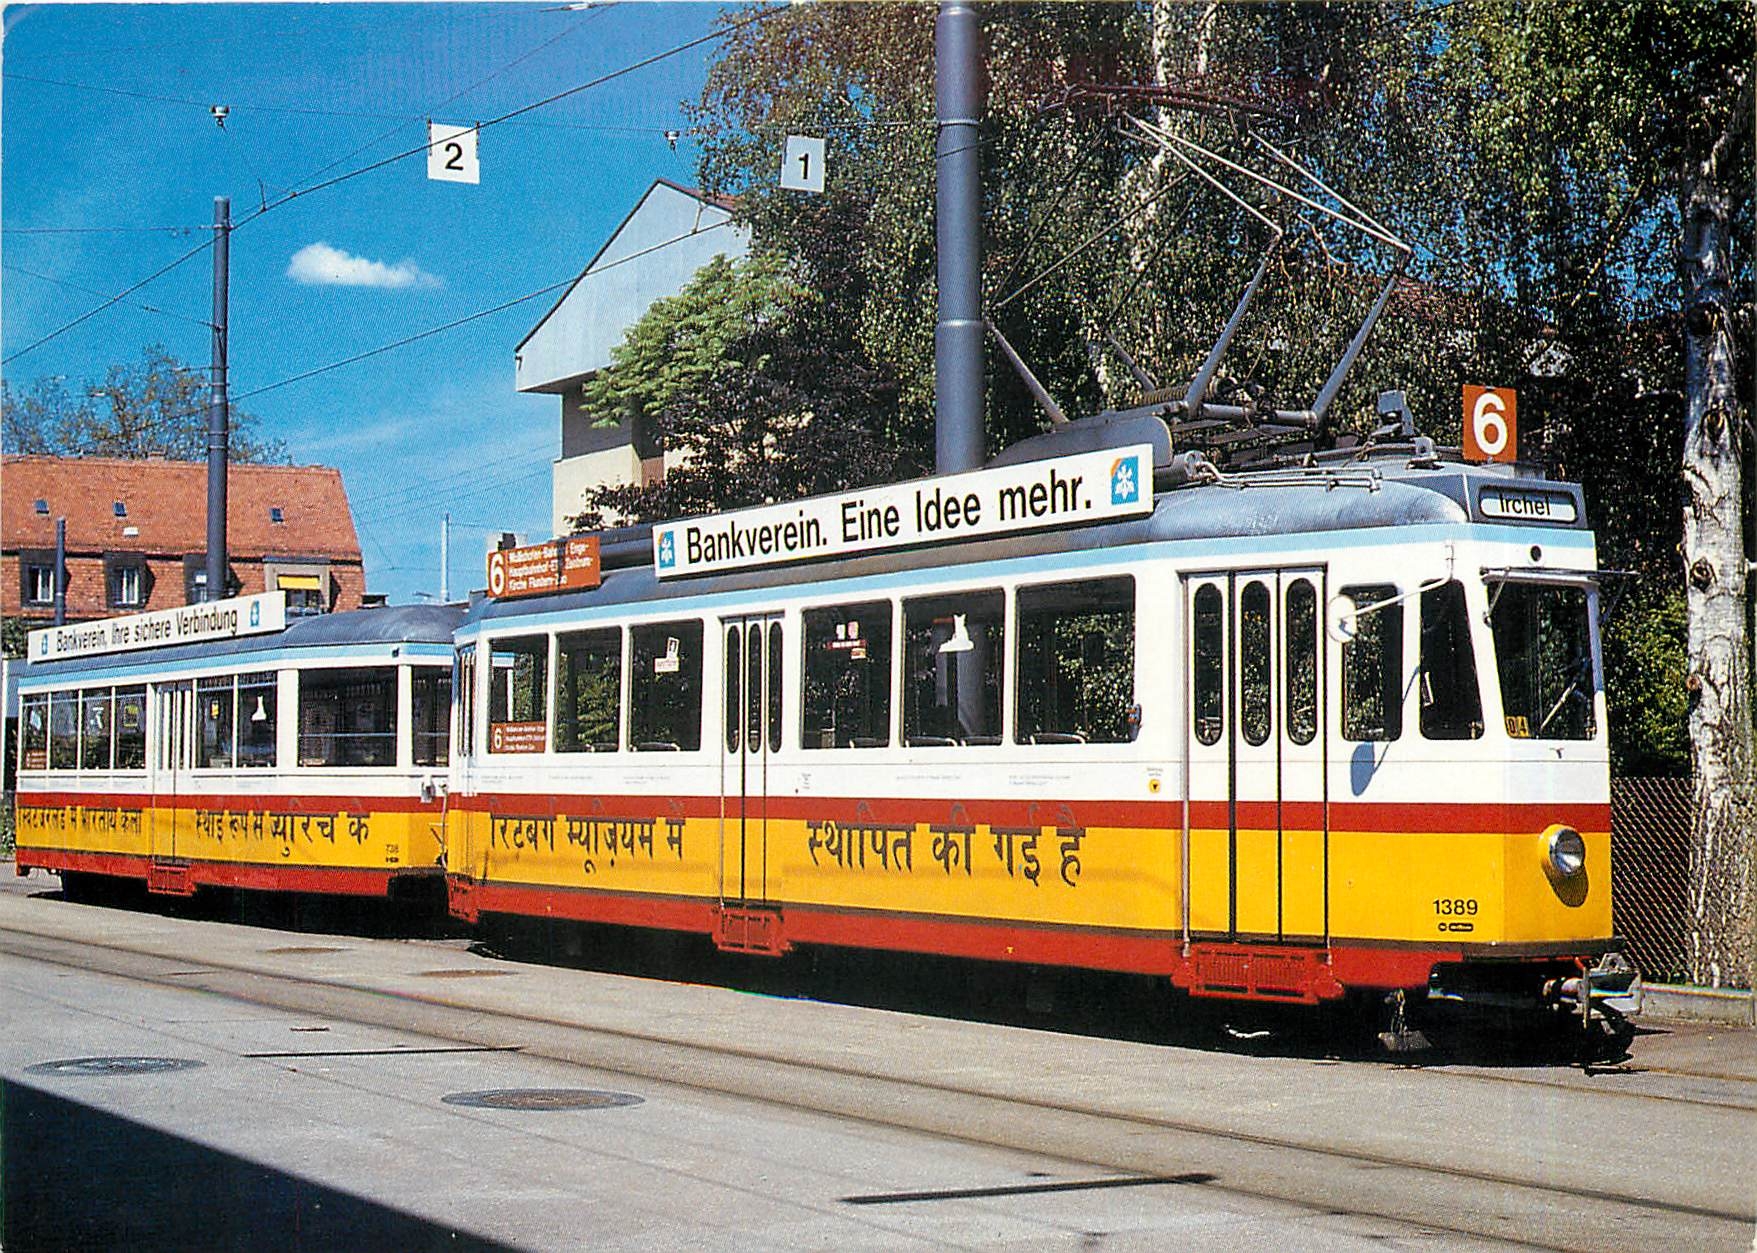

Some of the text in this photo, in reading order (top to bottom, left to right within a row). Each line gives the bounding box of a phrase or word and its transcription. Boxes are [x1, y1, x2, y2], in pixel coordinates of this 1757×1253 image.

[443, 141, 465, 171] 2
[797, 152, 810, 180] 1
[1472, 391, 1509, 456] 6
[687, 469, 1092, 565] Bankverein. Eine Idee mehr.
[1498, 492, 1552, 516] Irchel
[490, 553, 505, 595] 6
[111, 622, 130, 645] Ihre
[134, 615, 171, 643] sichere
[176, 606, 238, 635] Verbindung
[494, 728, 503, 749] 6
[1433, 898, 1478, 916] 1389
